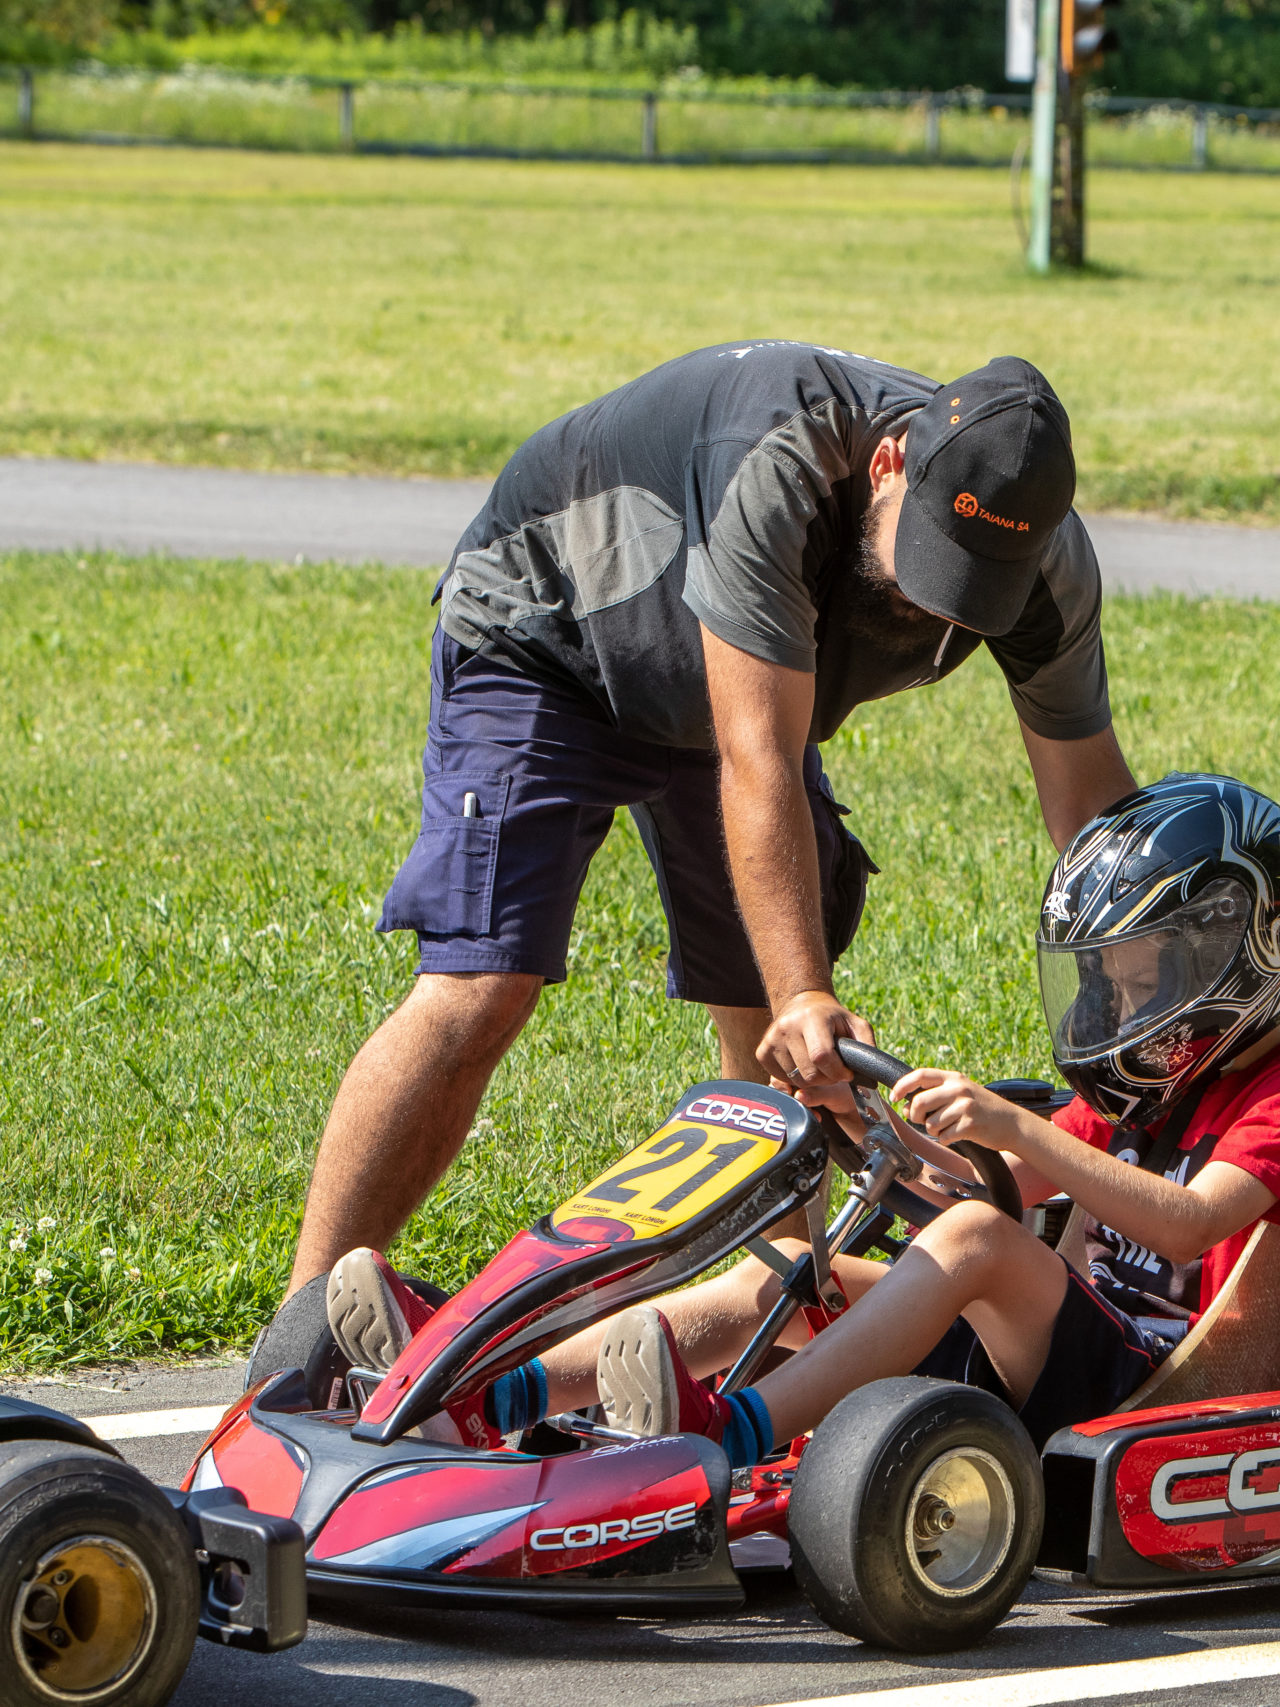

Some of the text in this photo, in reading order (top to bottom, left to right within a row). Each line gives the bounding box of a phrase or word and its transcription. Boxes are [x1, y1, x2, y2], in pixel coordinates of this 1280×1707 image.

[978, 508, 1029, 532] TAIANA SA
[685, 1098, 786, 1137] CORSE
[583, 1127, 759, 1212] 21
[529, 1501, 697, 1551] CORSE
